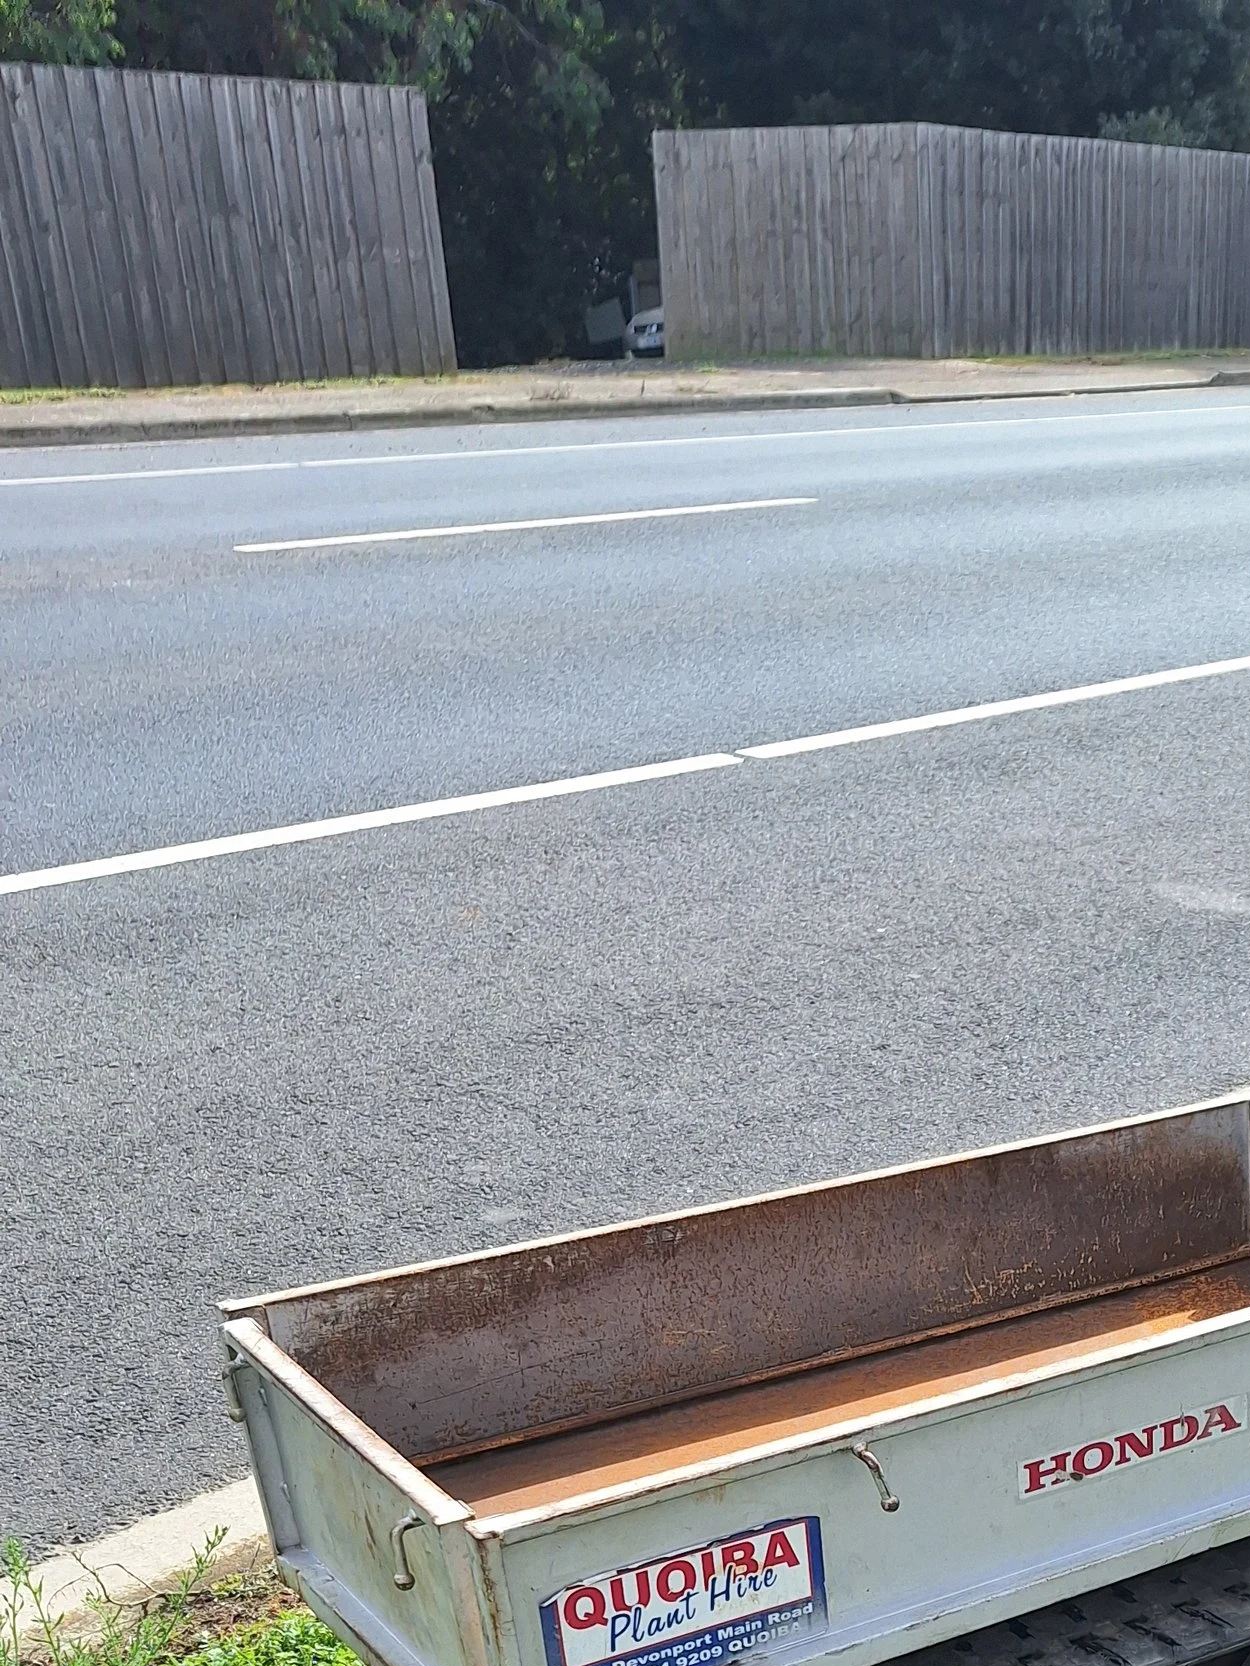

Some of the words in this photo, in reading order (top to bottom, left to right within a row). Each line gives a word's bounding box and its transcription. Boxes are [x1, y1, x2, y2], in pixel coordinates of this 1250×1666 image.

[1023, 1404, 1242, 1493] HONDA
[563, 1531, 800, 1630] QUOIBA
[610, 1590, 700, 1652] Plant
[710, 1565, 778, 1612] Hire
[717, 1619, 763, 1640] Main
[768, 1602, 814, 1625] Road
[728, 1621, 801, 1652] QUOIBA
